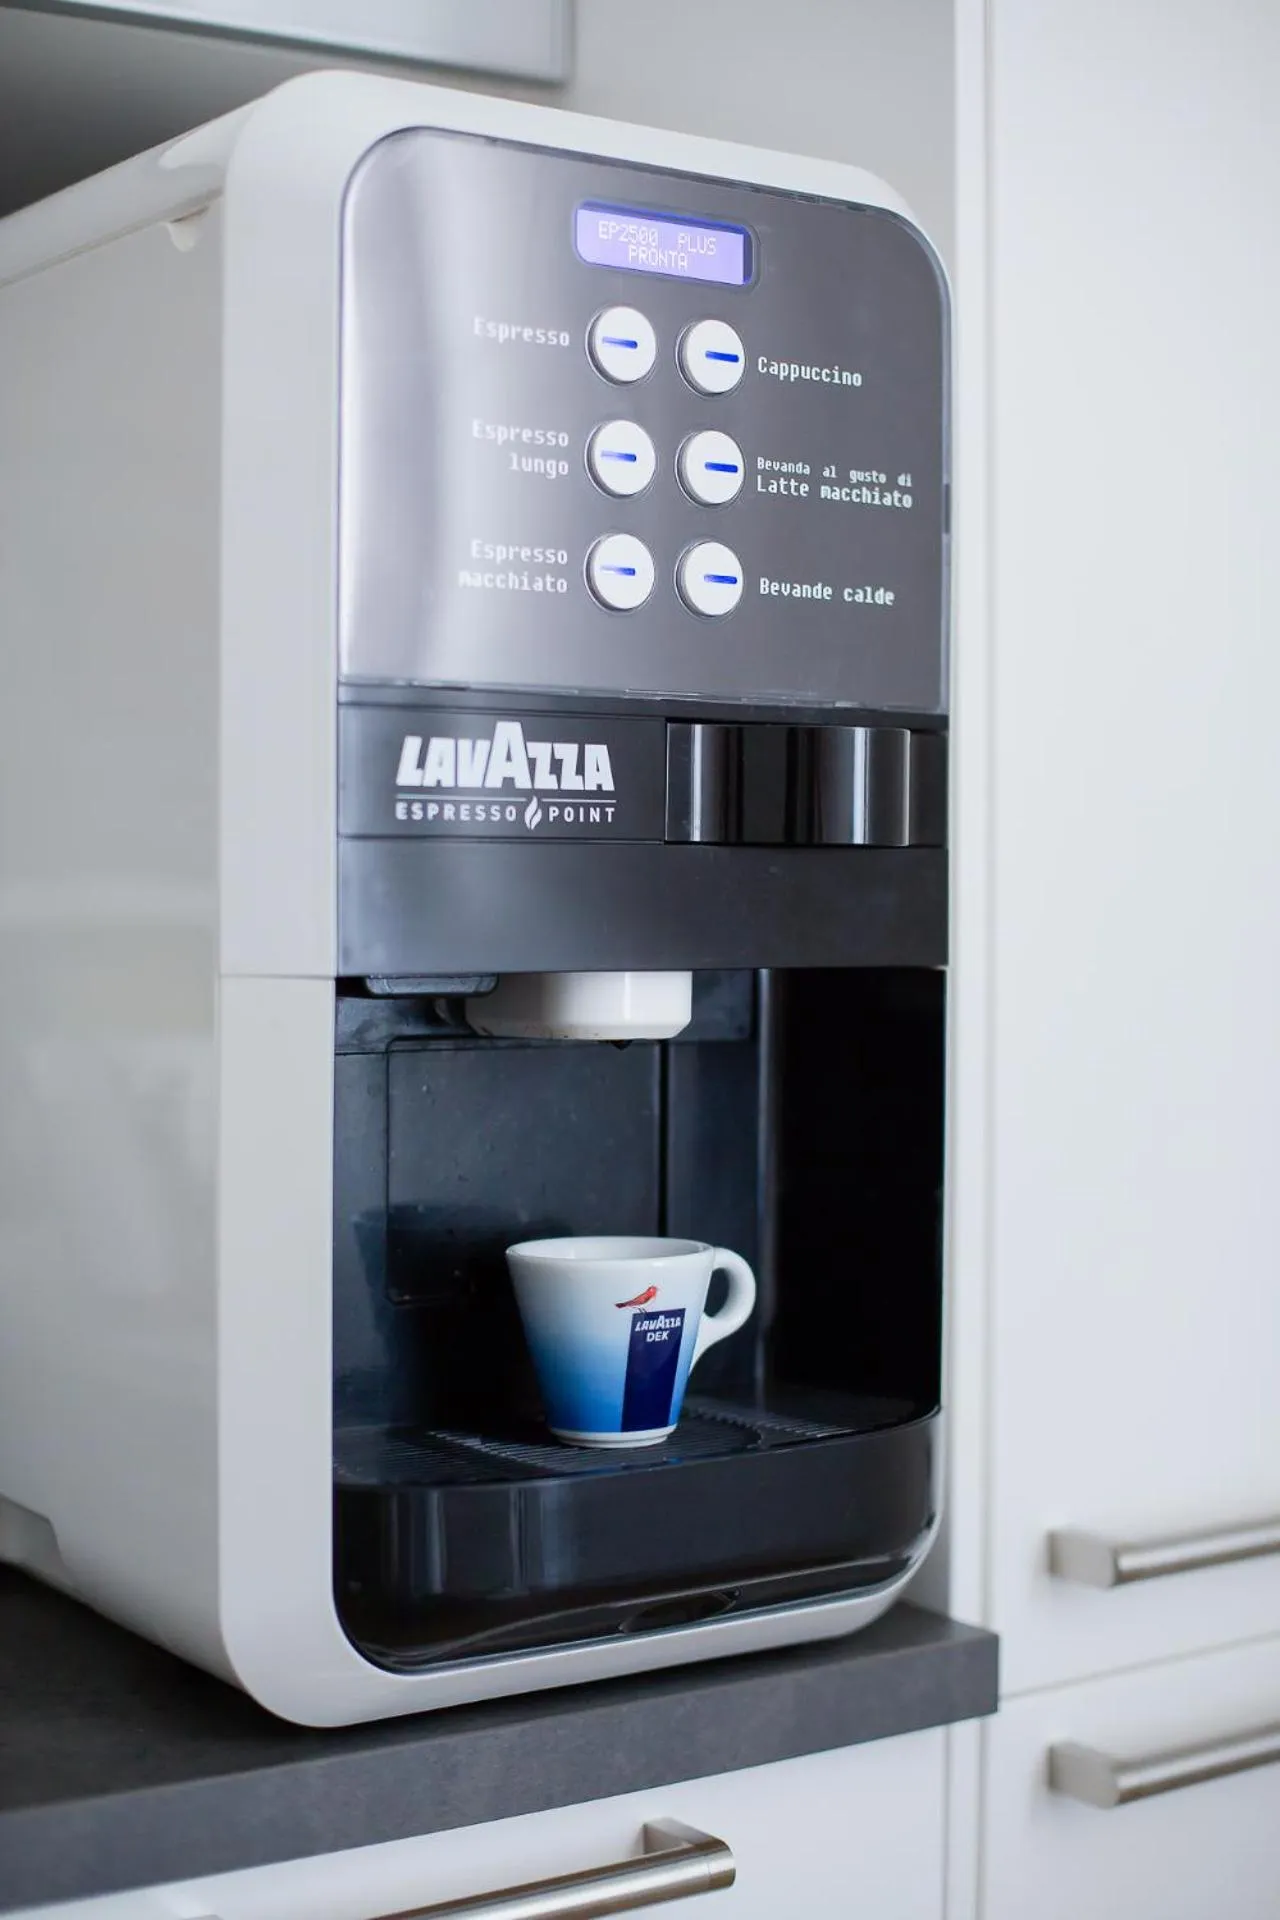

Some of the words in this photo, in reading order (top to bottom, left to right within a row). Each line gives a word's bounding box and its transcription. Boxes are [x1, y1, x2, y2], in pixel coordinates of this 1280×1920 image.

[598, 220, 658, 246] EP2500
[678, 234, 717, 256] PLUS
[629, 245, 688, 270] PRONTA
[473, 317, 570, 347] Espresso
[758, 356, 862, 387] Cappuccino
[472, 420, 569, 449] Espresso
[508, 453, 569, 479] lungo
[757, 457, 810, 476] Bevanda
[823, 465, 836, 478] al
[849, 468, 886, 485] gusto
[898, 471, 912, 487] di
[757, 475, 809, 497] Latte
[820, 481, 912, 508] macchiato
[471, 540, 568, 567] Espresso
[459, 571, 568, 594] macchiato
[759, 577, 832, 600] Bevande
[843, 585, 895, 606] calde
[395, 721, 615, 791] LAVAZZA
[395, 802, 516, 822] ESPRESSO
[549, 806, 615, 823] POINT
[634, 1315, 681, 1331] LAVAZZA
[646, 1331, 670, 1342] DEK
